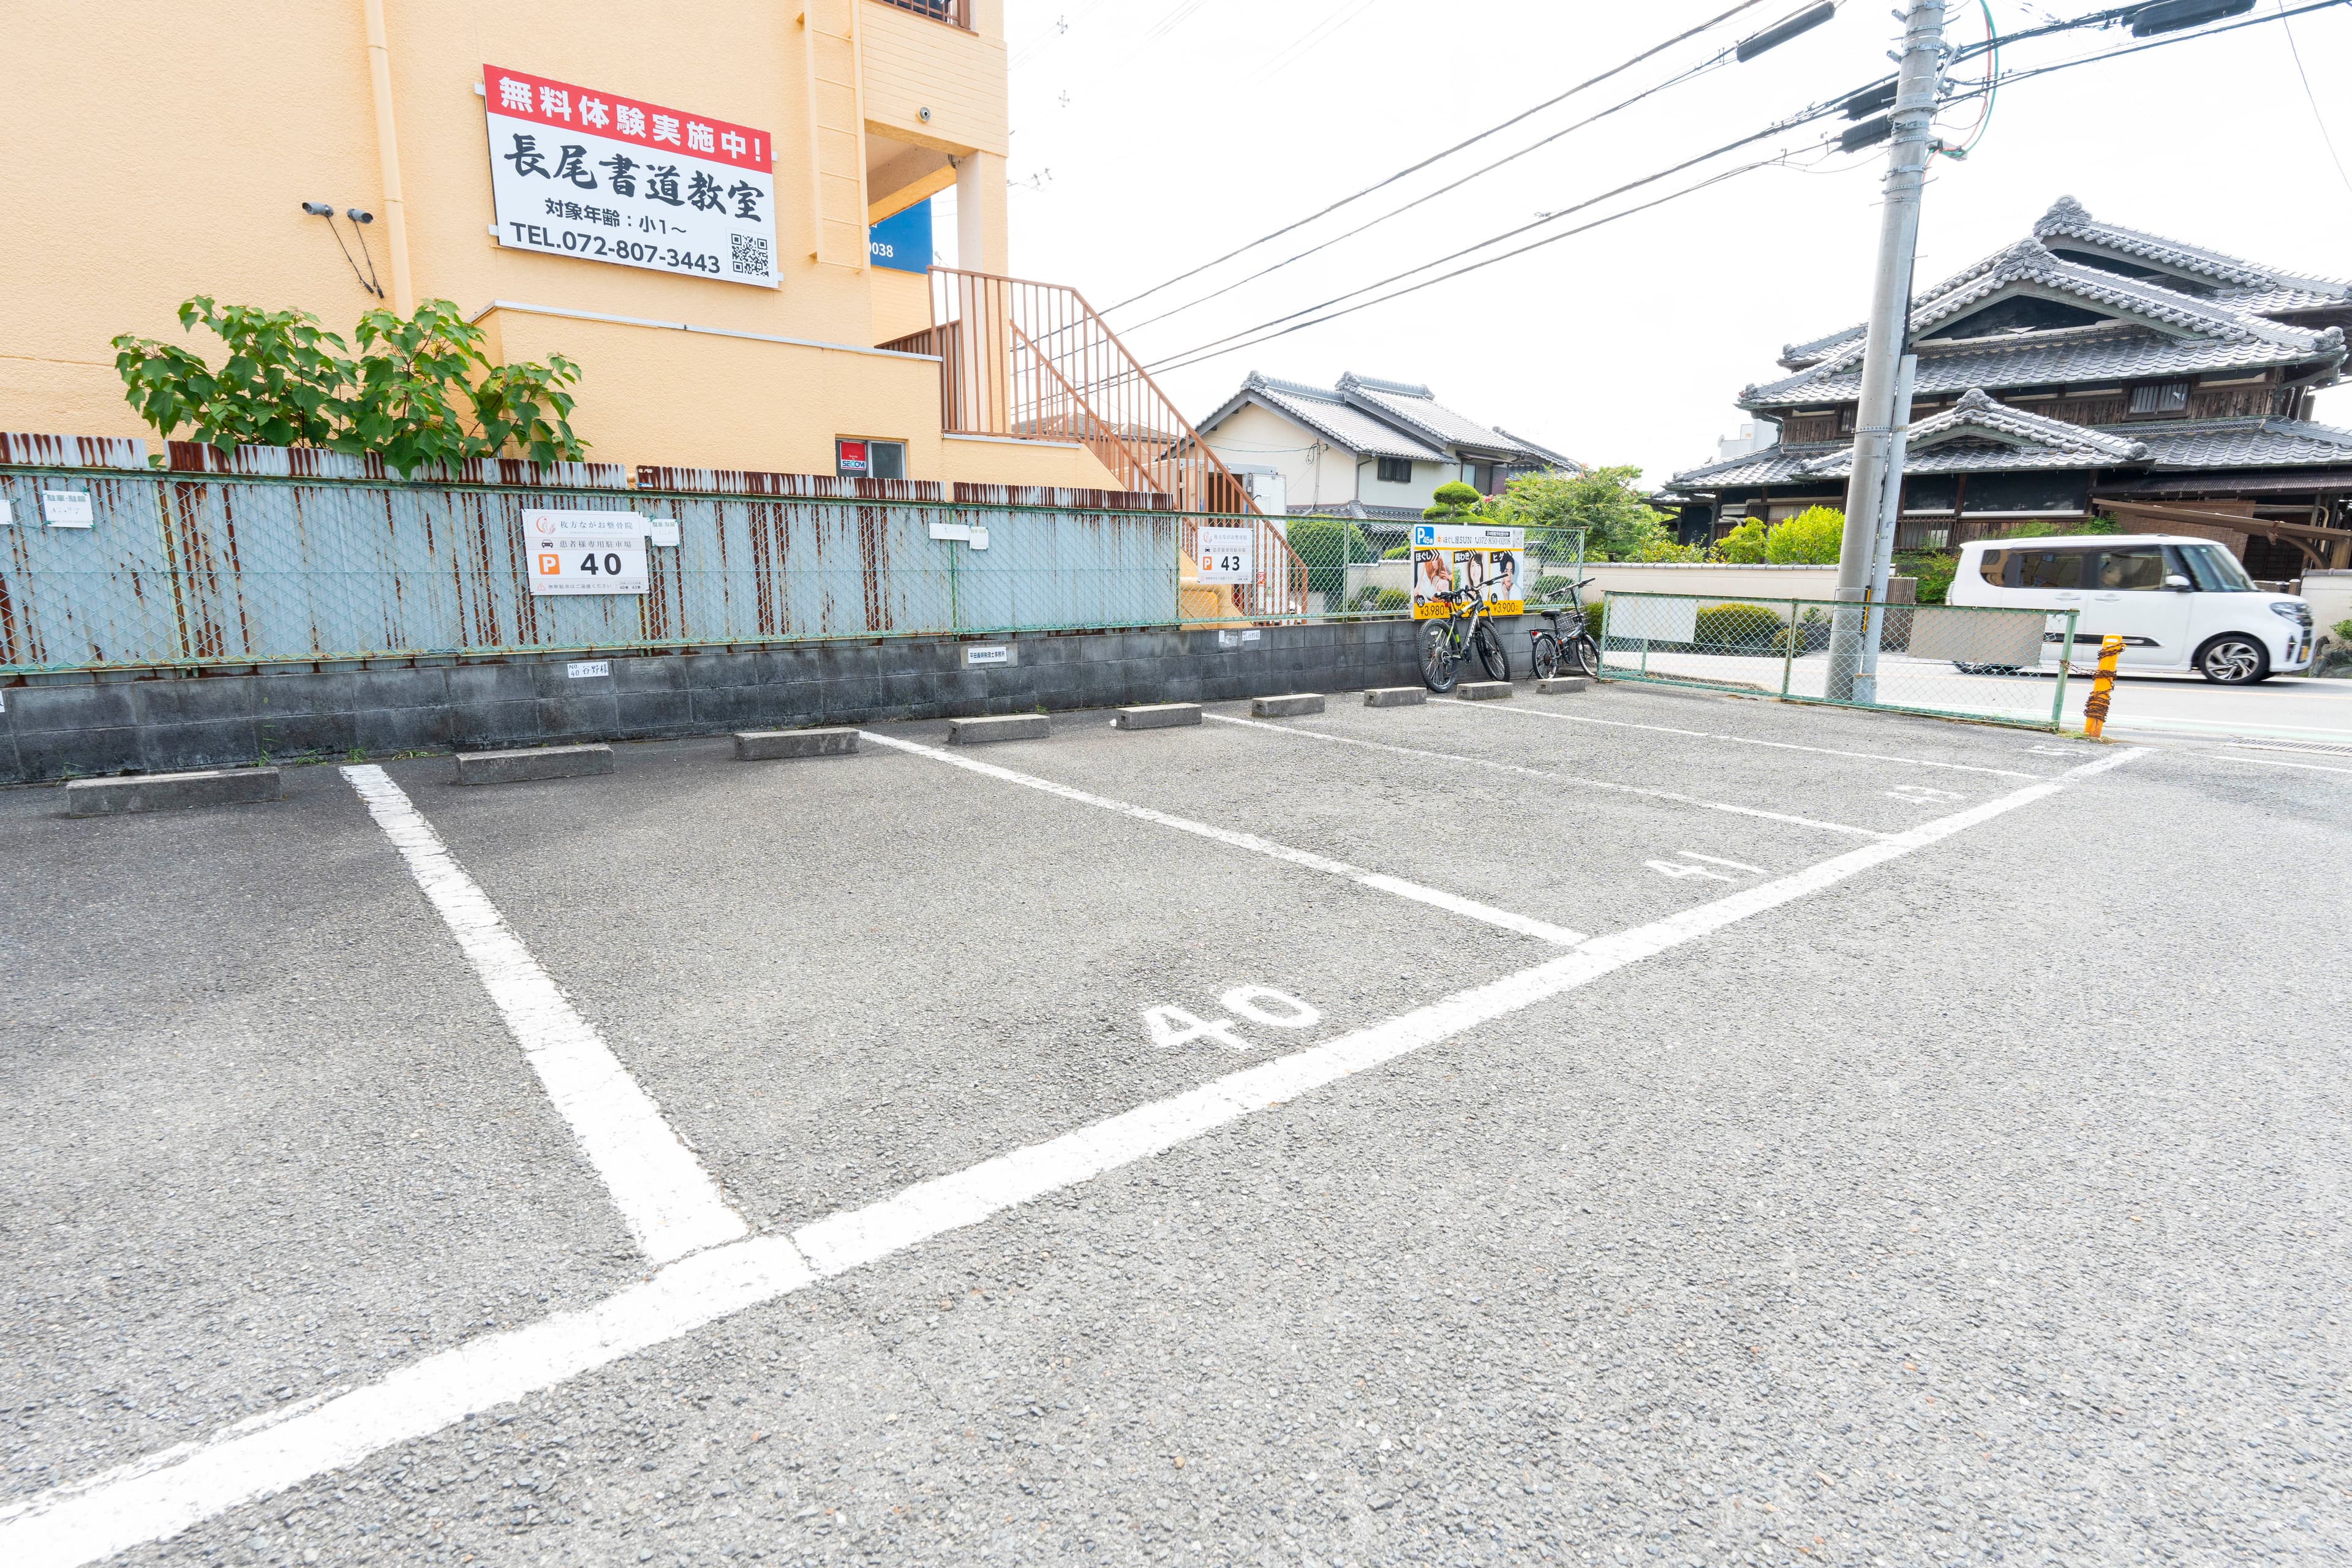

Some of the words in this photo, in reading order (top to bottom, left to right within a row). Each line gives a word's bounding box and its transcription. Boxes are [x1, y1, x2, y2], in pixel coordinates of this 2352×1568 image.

[499, 75, 762, 162] 無料体験実施中!
[503, 133, 764, 222] 長尾書道教室
[510, 222, 720, 274] TEL.072-807-3443
[542, 556, 556, 572] P
[580, 553, 622, 575] 40
[1221, 556, 1240, 571] 43
[1415, 552, 1431, 561] ほぐし
[1454, 552, 1470, 562] 両わき
[1493, 552, 1504, 561] ヒゲ
[1645, 850, 1770, 883] 41
[1143, 985, 1321, 1052] 40
